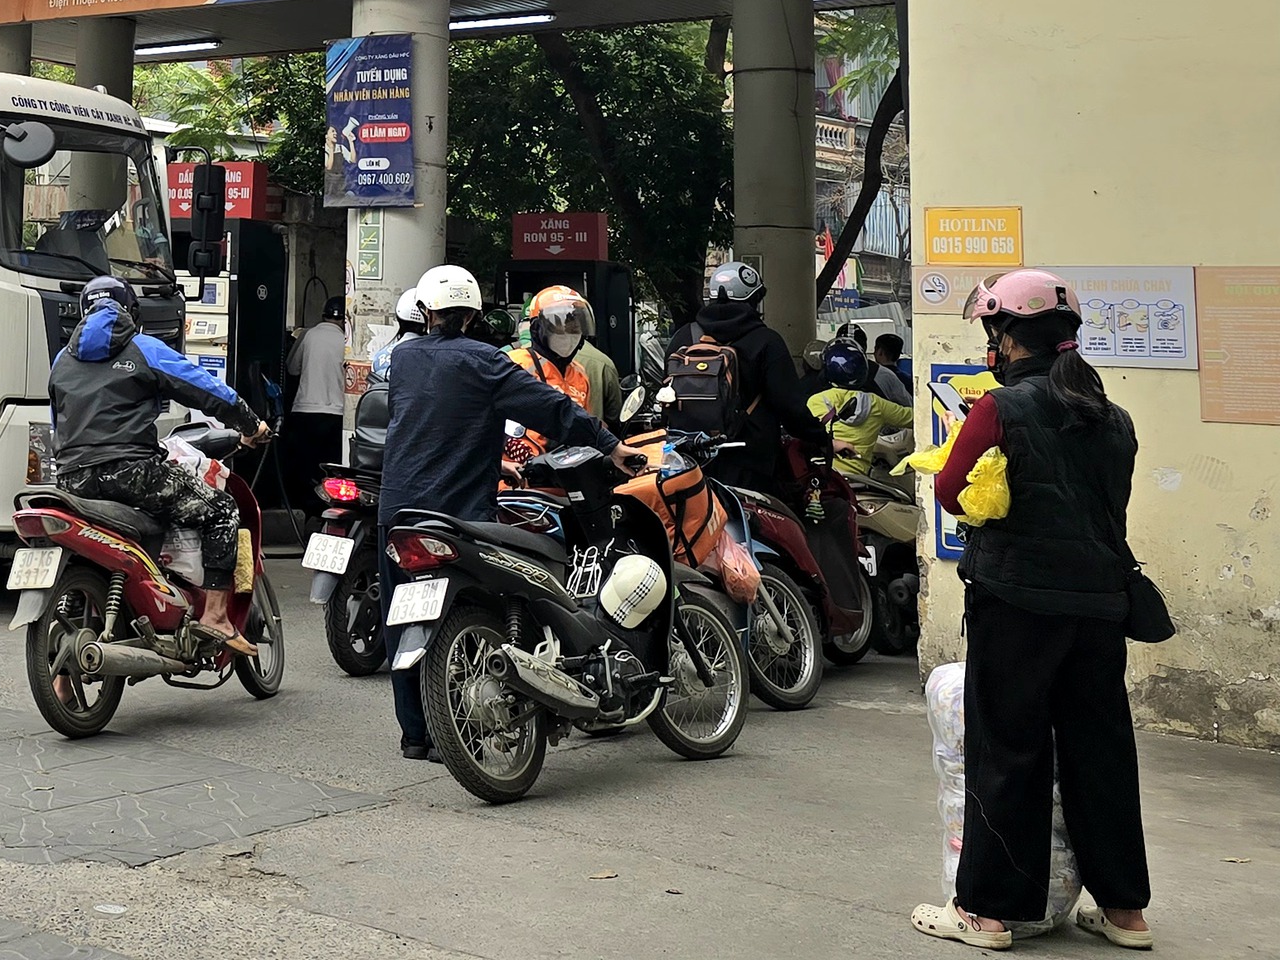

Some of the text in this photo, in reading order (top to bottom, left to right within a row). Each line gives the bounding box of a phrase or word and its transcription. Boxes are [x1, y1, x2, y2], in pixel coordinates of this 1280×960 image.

[356, 66, 407, 83] TUYỂN DỤNG
[334, 86, 410, 103] NHÂN VIÊN BÁN HÀNG
[11, 95, 37, 109] CÔNG
[38, 100, 48, 110] TY
[50, 100, 71, 114] CÔNG
[72, 105, 90, 118] VIÊN
[370, 126, 386, 138] LÀM
[388, 127, 407, 137] NGAY
[225, 169, 242, 183] ĂNG
[358, 172, 410, 185] 0967.400.602
[228, 187, 250, 199] 95-III
[540, 218, 570, 229] XĂNG
[939, 218, 1007, 232] HOTLINE
[523, 232, 547, 242] RON
[550, 232, 564, 242] 95
[575, 232, 587, 242] III
[933, 236, 1014, 254] 0915 990 658
[959, 387, 981, 396] Chào
[315, 537, 347, 556] 29-AE
[20, 550, 54, 567] 30-K6
[305, 552, 346, 571] 038.63
[399, 581, 439, 603] 29-BM
[391, 600, 439, 621] 034.90
